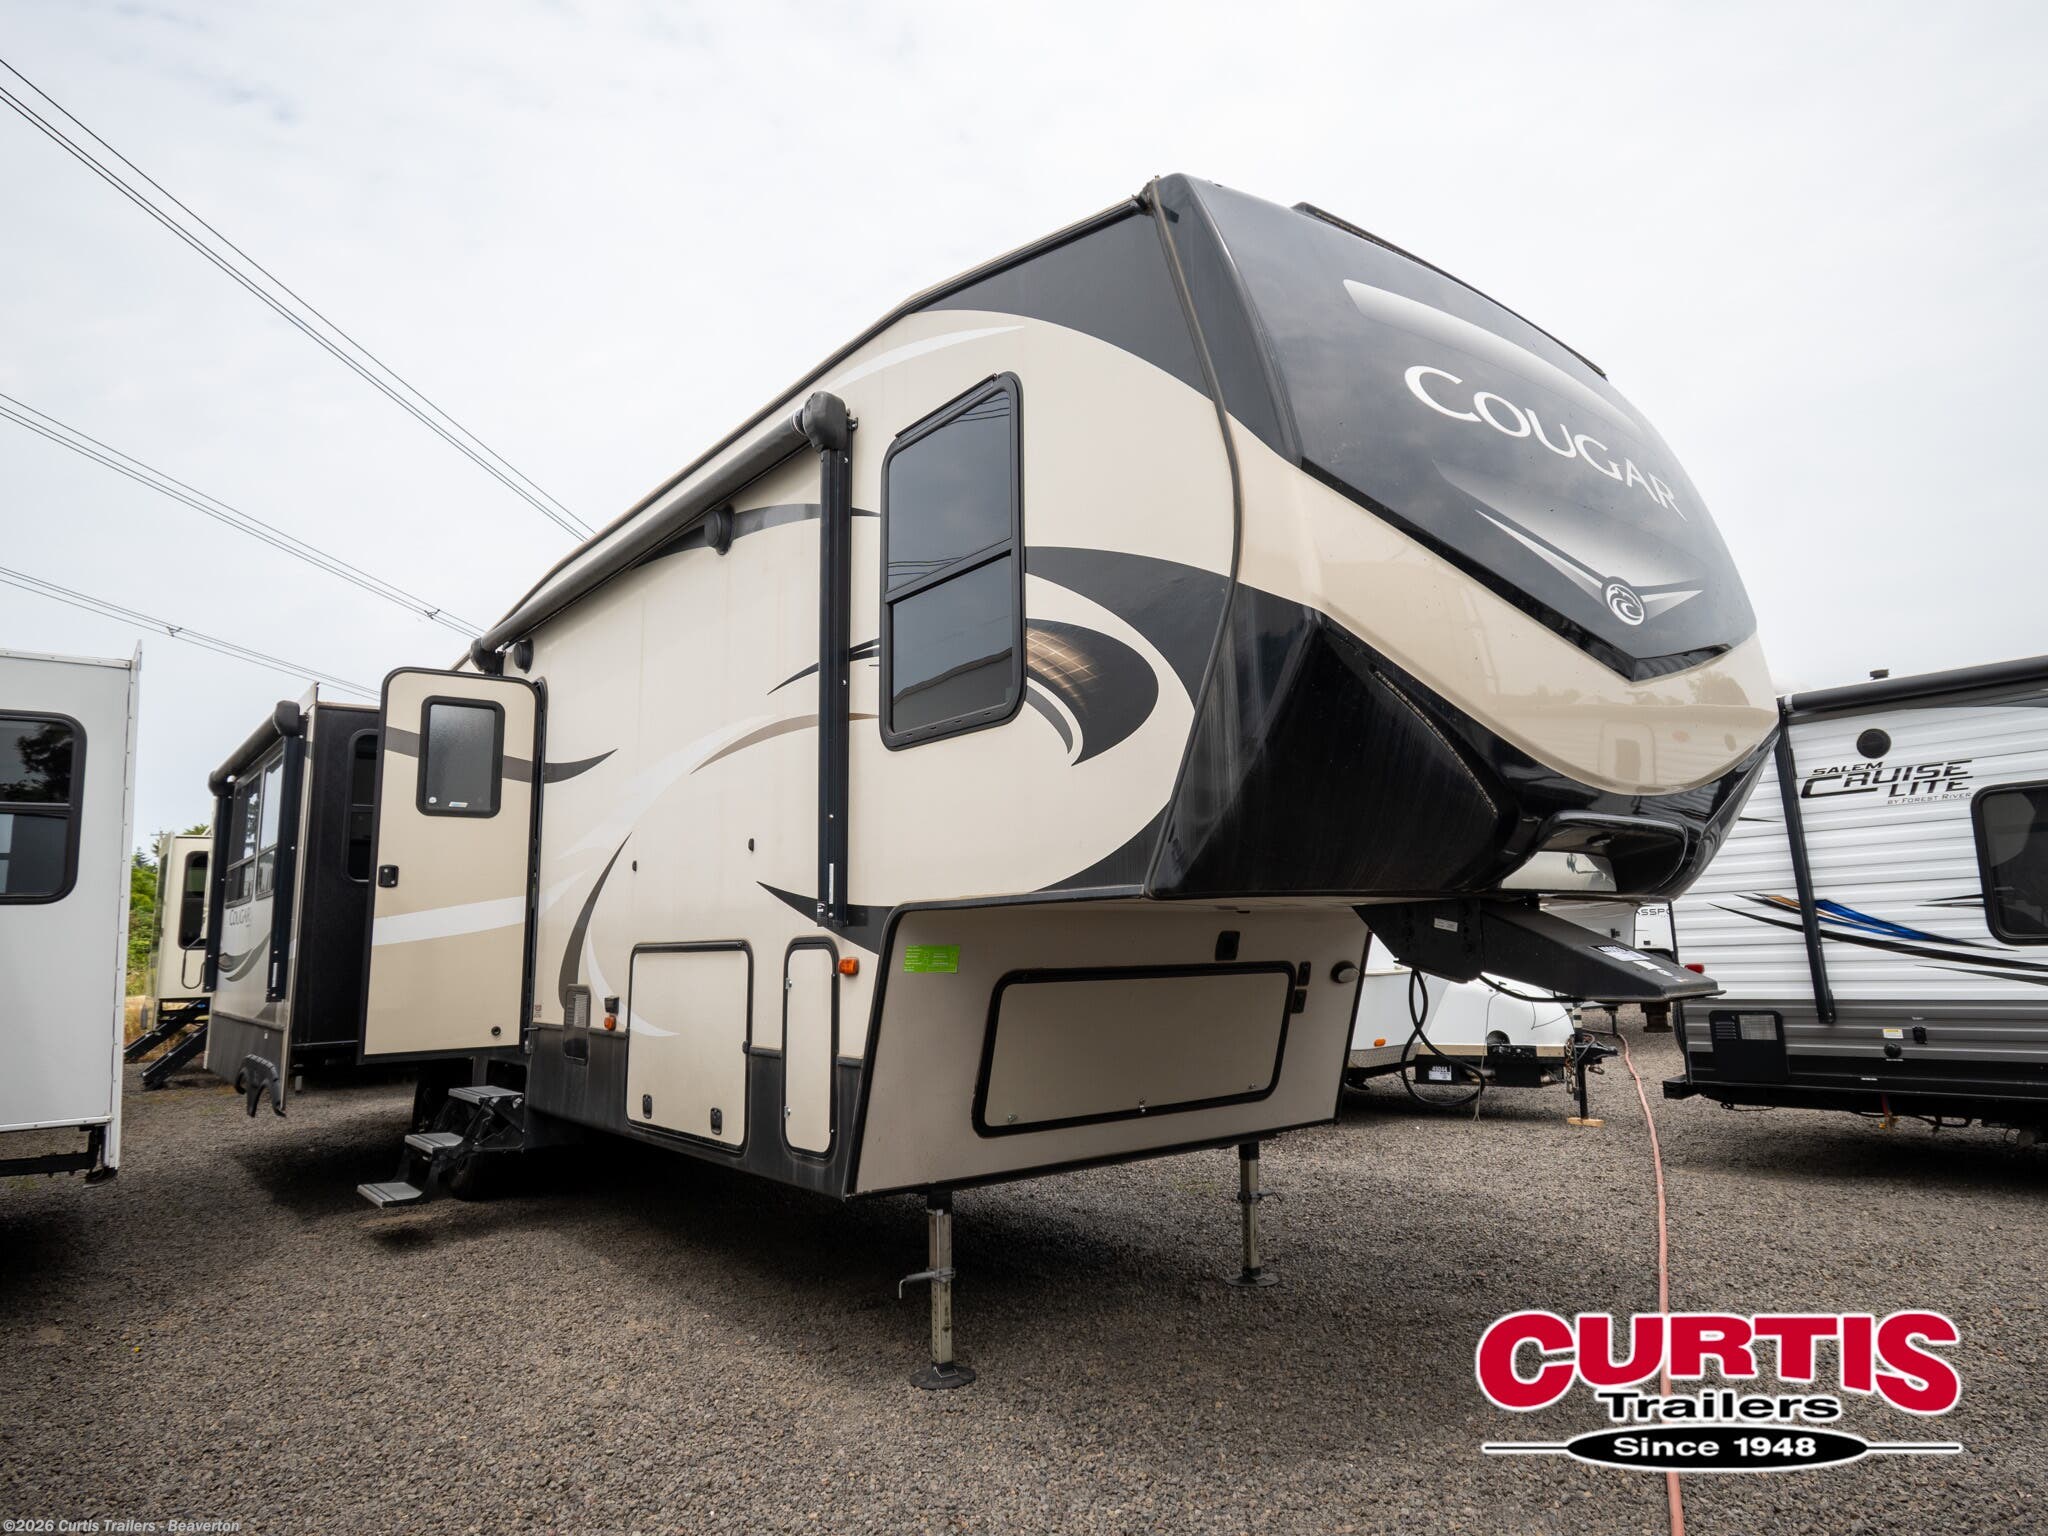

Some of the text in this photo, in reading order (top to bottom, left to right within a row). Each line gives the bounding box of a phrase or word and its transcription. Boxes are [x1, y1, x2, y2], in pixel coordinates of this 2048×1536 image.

[1404, 365, 1687, 521] COUGAR
[1800, 759, 1973, 799] CRUISE
[1812, 761, 1884, 775] SALEM
[1888, 775, 1974, 798] LITE
[1901, 795, 1940, 804] FOREST
[1942, 792, 1973, 801] RIVER
